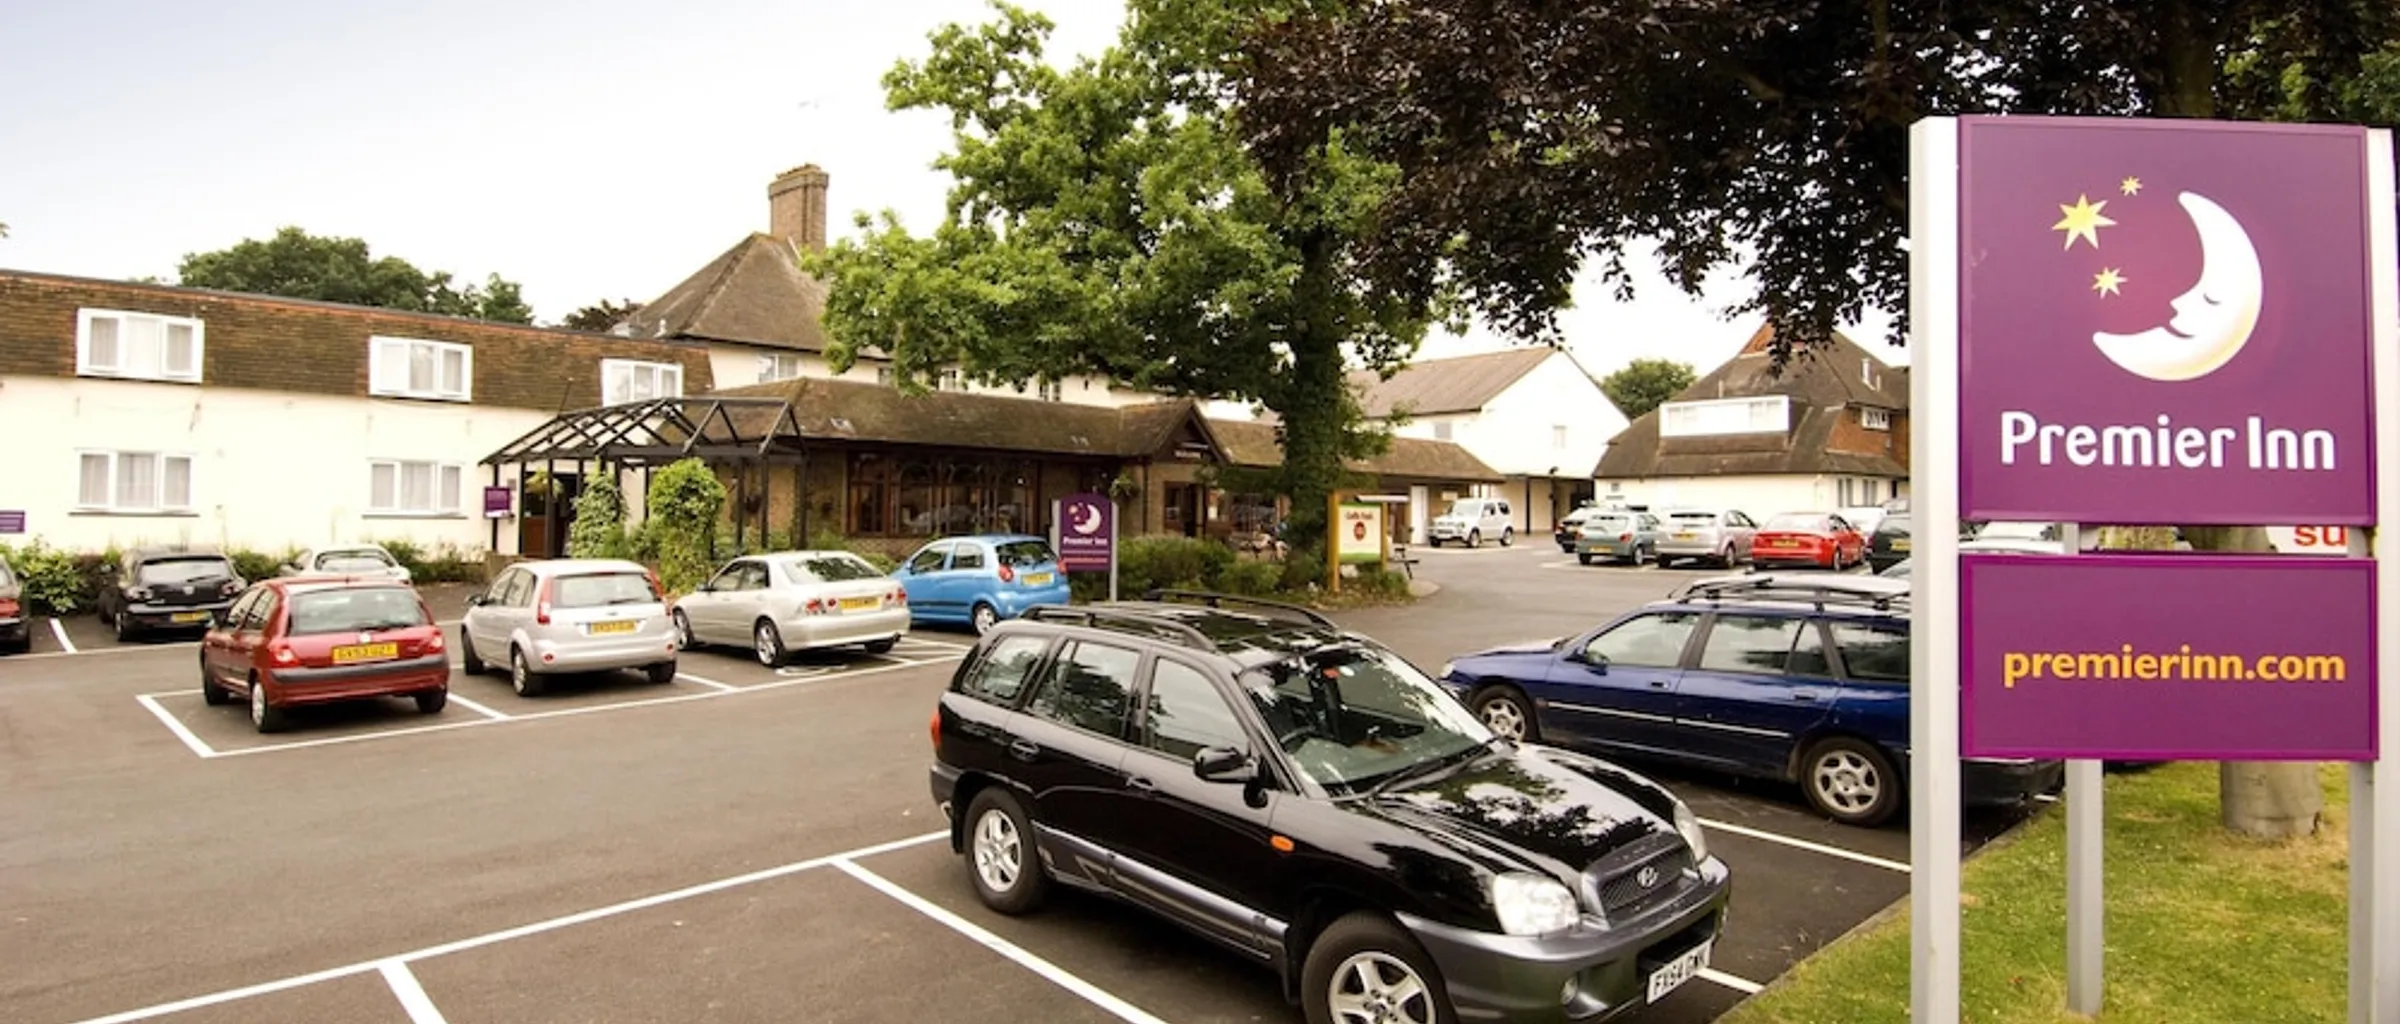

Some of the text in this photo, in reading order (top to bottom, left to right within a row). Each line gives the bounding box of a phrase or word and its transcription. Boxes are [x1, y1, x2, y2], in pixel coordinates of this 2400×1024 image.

[2000, 411, 2336, 470] Premier Inn
[2294, 524, 2347, 546] su
[2003, 645, 2346, 688] premierinn.com
